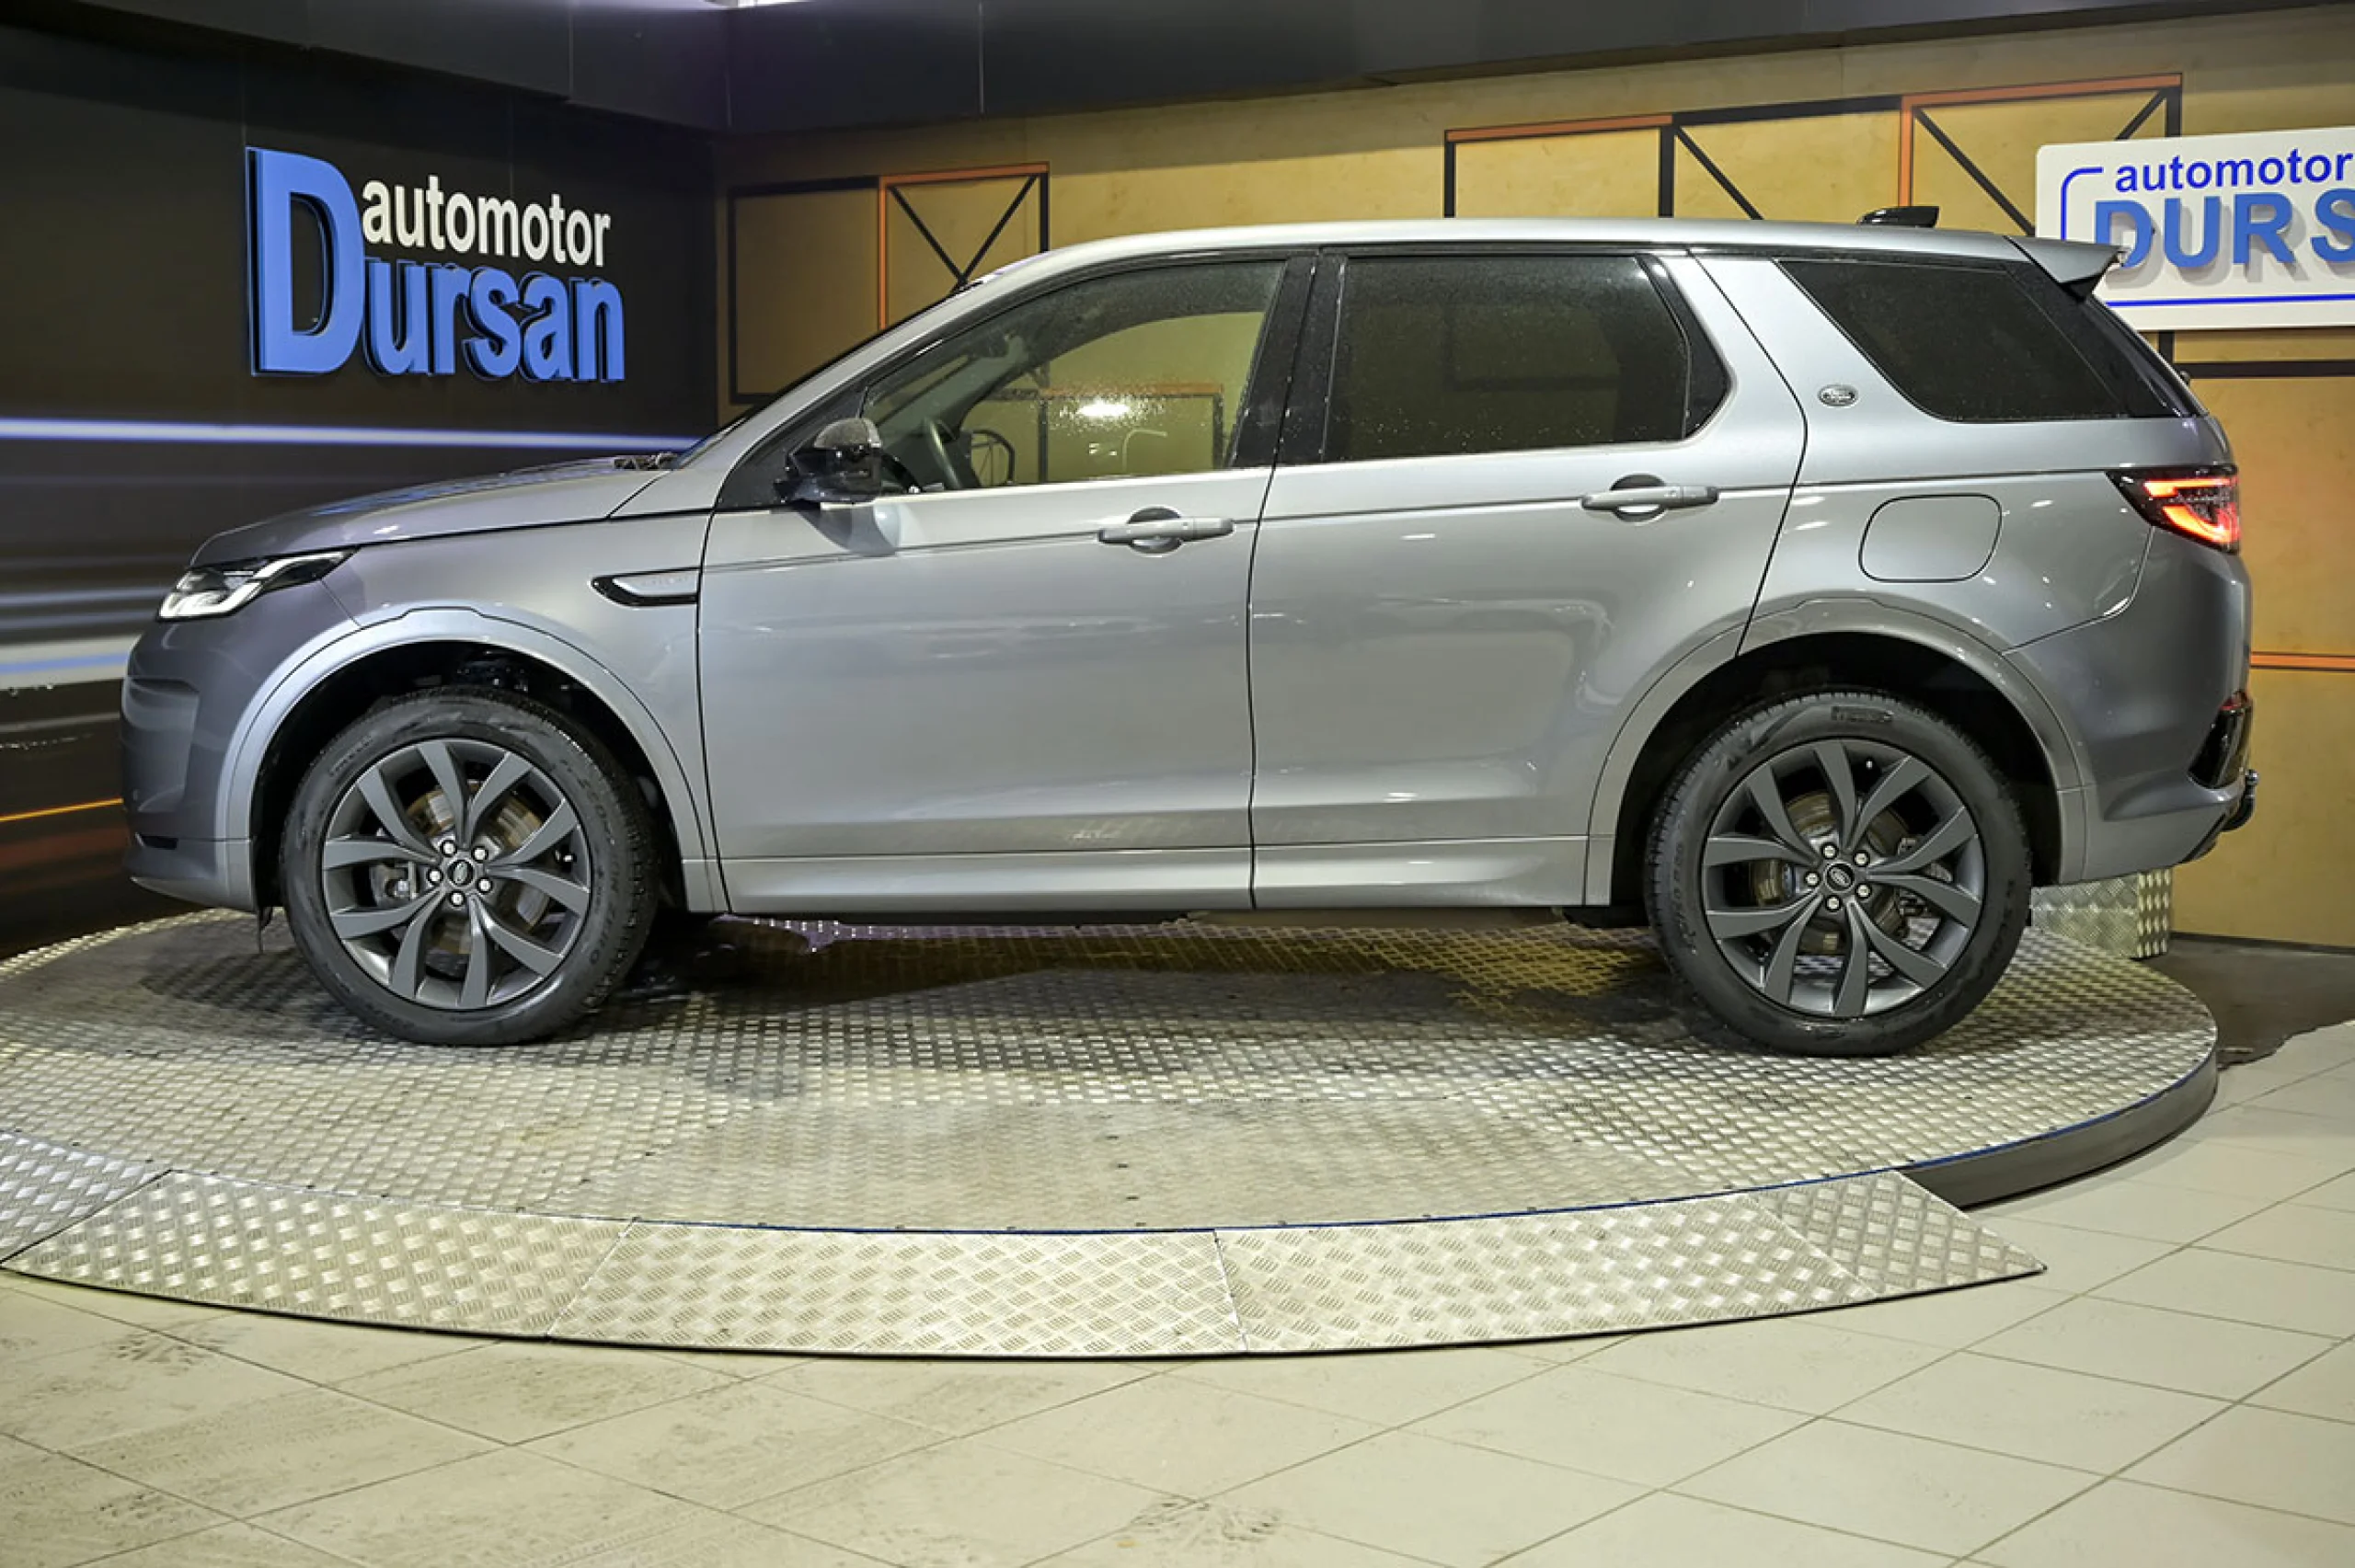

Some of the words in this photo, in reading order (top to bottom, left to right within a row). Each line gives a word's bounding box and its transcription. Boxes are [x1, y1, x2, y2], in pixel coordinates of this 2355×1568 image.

[2116, 147, 2355, 192] automotor
[246, 146, 626, 383] Dursan
[362, 174, 611, 267] automotor
